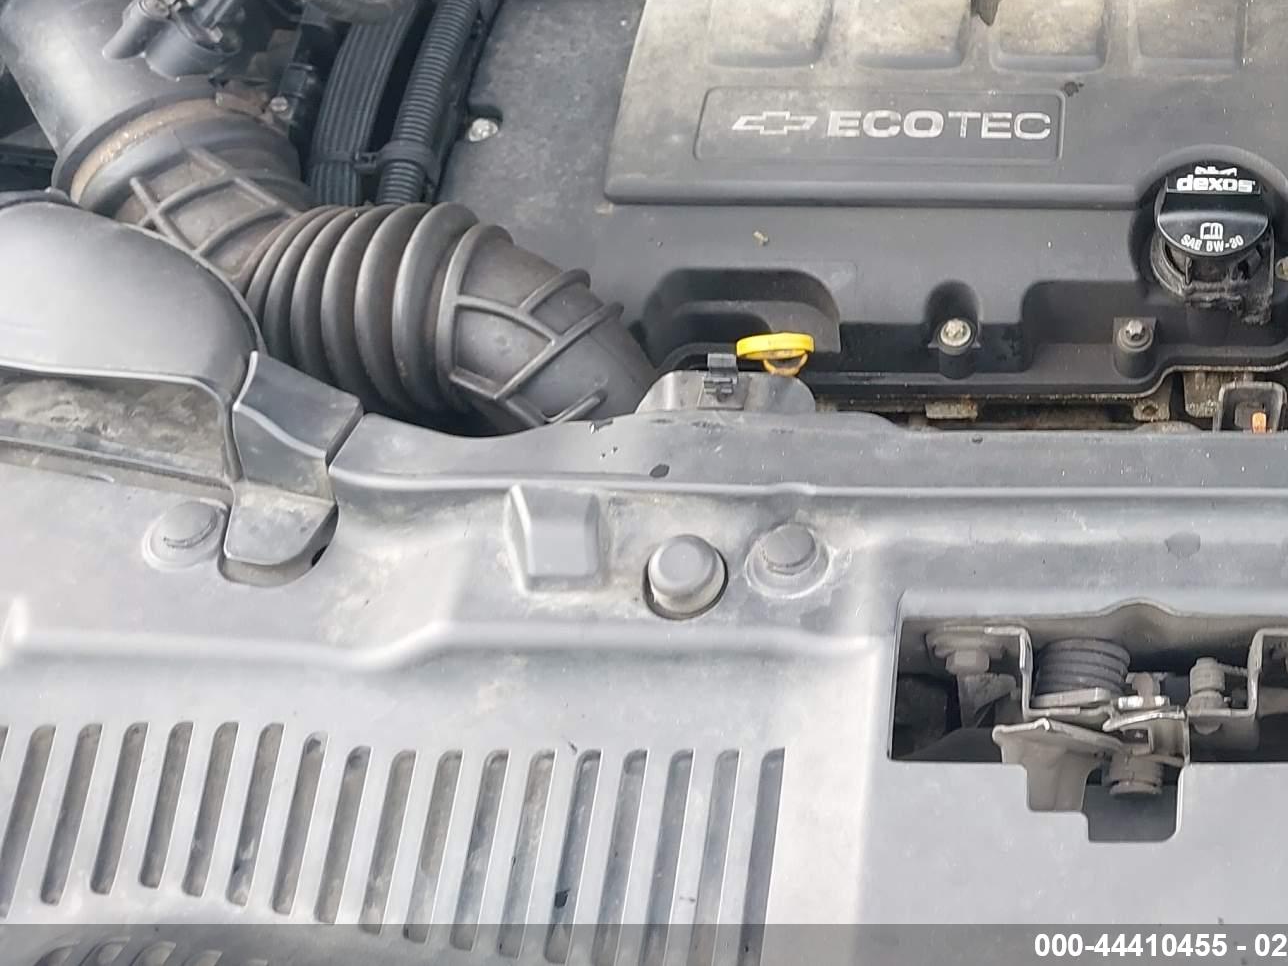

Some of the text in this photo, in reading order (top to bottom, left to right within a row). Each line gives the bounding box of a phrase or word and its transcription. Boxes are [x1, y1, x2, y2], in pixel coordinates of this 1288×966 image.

[827, 110, 1051, 140] ECOTEC
[1176, 174, 1253, 193] dexos
[1181, 234, 1244, 253] SAE 5W-30
